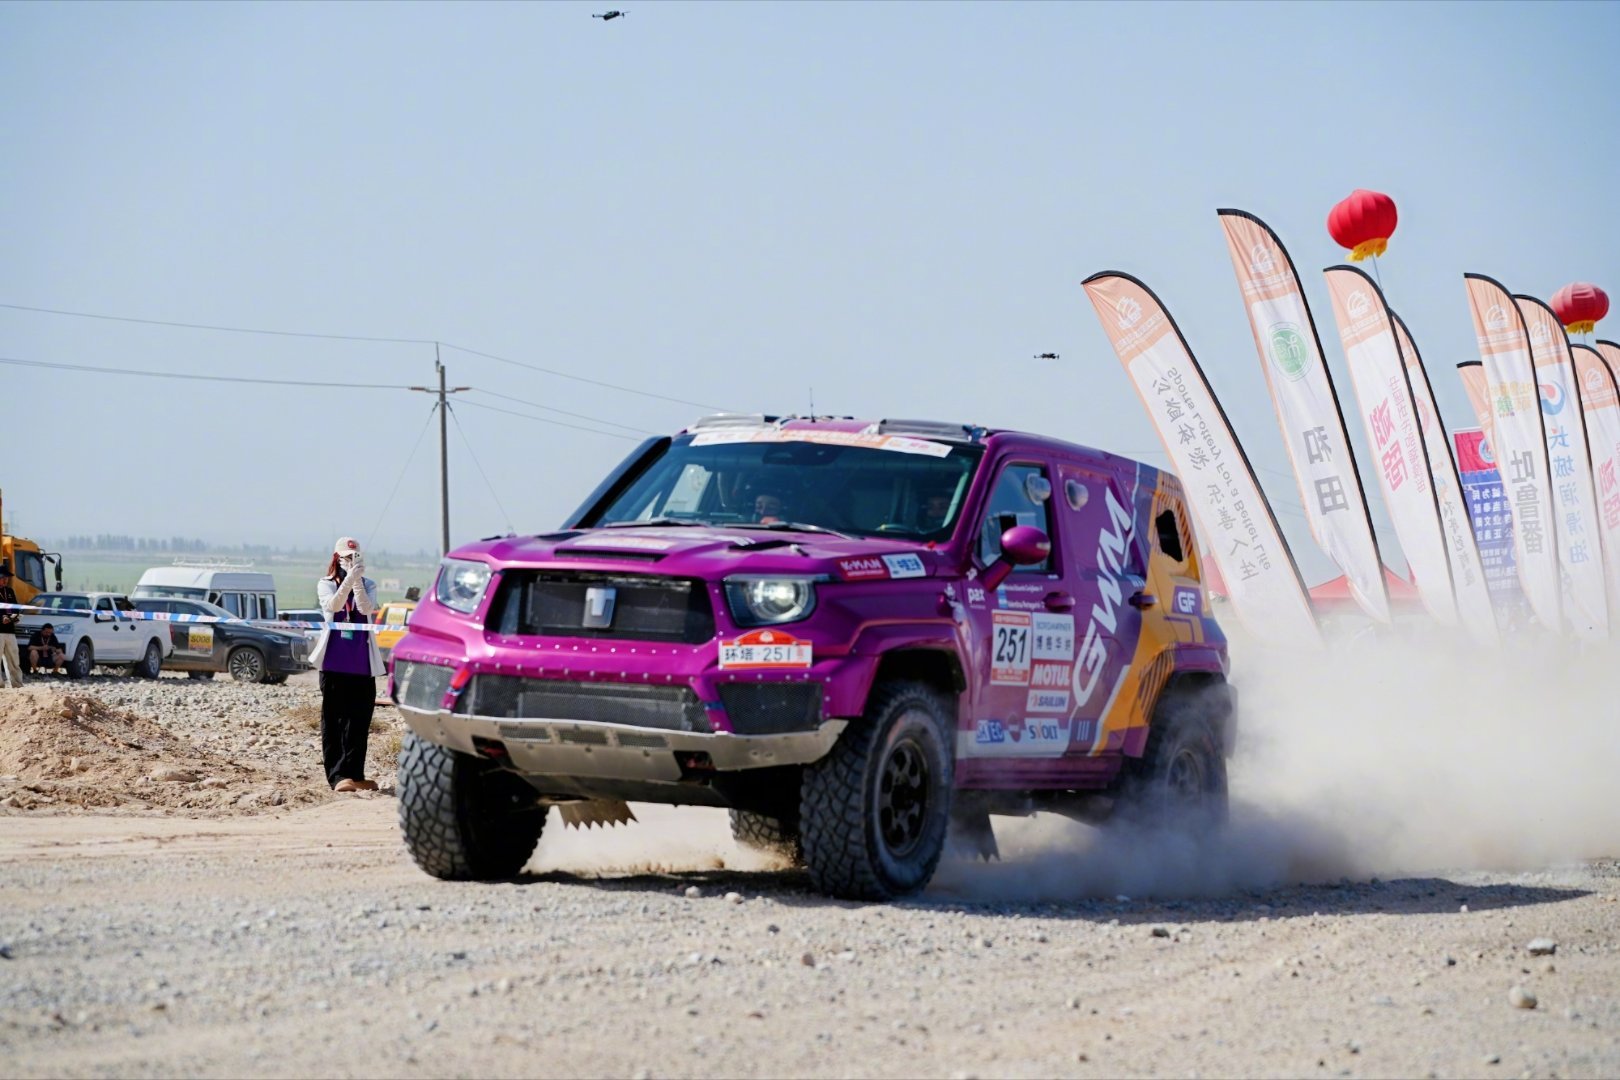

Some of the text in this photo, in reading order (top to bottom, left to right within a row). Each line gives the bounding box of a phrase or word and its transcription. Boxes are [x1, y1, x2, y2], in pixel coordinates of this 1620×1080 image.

[1072, 487, 1132, 707] GWM
[725, 647, 791, 662] 环塔 251
[996, 627, 1027, 663] 251
[1031, 664, 1071, 686] MOTUL
